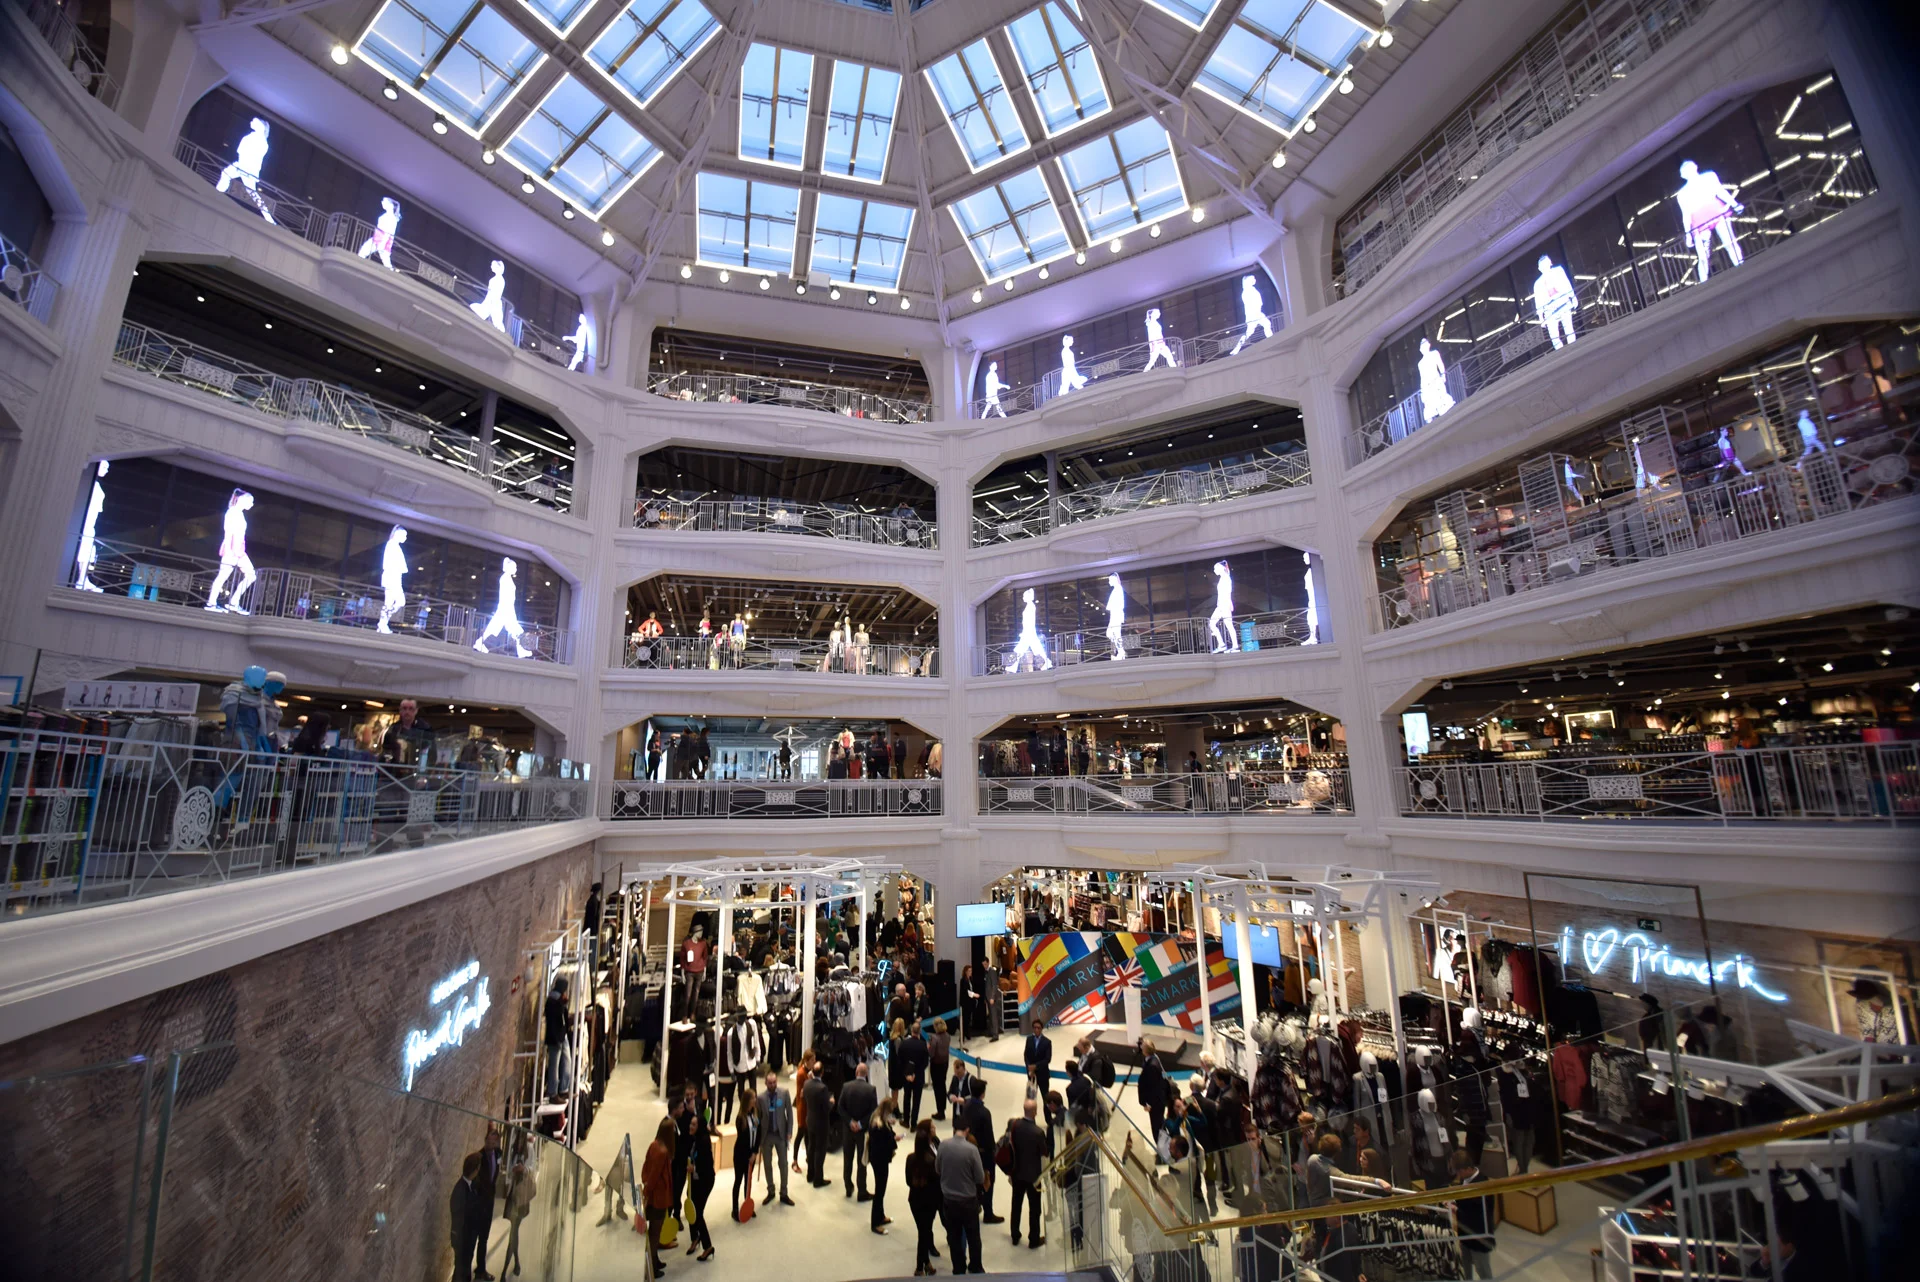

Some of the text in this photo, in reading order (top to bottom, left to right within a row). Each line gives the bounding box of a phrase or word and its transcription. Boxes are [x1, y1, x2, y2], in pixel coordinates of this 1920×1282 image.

[1622, 933, 1788, 1002] Primark
[1036, 963, 1099, 1018] PRIMARK
[1074, 1000, 1086, 1010] USA
[1141, 975, 1200, 1010] RIMARK
